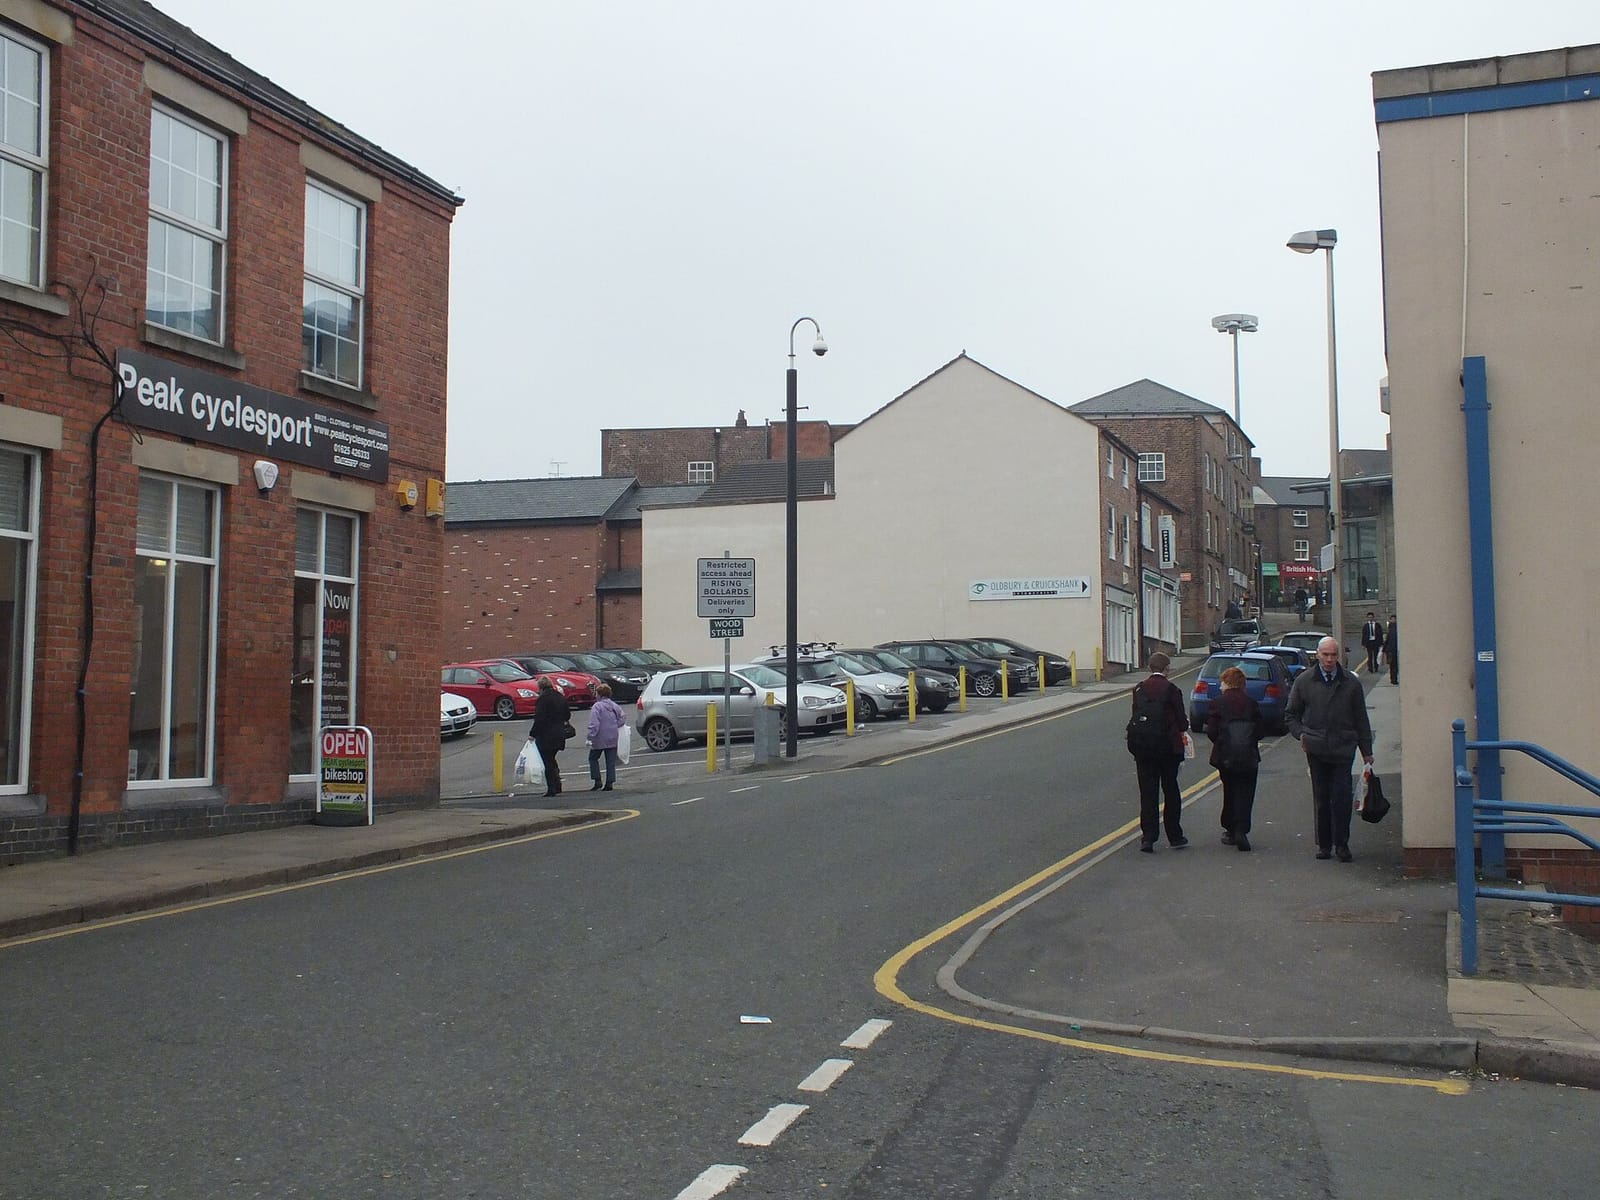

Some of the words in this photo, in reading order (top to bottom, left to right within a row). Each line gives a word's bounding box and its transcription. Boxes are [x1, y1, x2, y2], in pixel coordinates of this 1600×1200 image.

[118, 362, 184, 415] Peak
[190, 391, 312, 447] cyclesport
[329, 417, 351, 430] CLOTHING
[352, 423, 366, 433] PARTS
[313, 425, 389, 452] www.peakcyclesport.com
[333, 443, 350, 455] 01625
[706, 561, 747, 569] Restricted
[1286, 565, 1306, 573] British
[991, 581, 1021, 591] OLDBURY
[1024, 581, 1030, 590] &
[1031, 579, 1080, 590] CRUICKSHANK
[323, 589, 351, 611] Now
[707, 598, 746, 606] Deliveries
[718, 607, 735, 615] only
[714, 620, 741, 628] WOOD
[711, 628, 743, 637] STREET
[322, 732, 366, 755] OPEN
[324, 768, 364, 784] bikeshop
